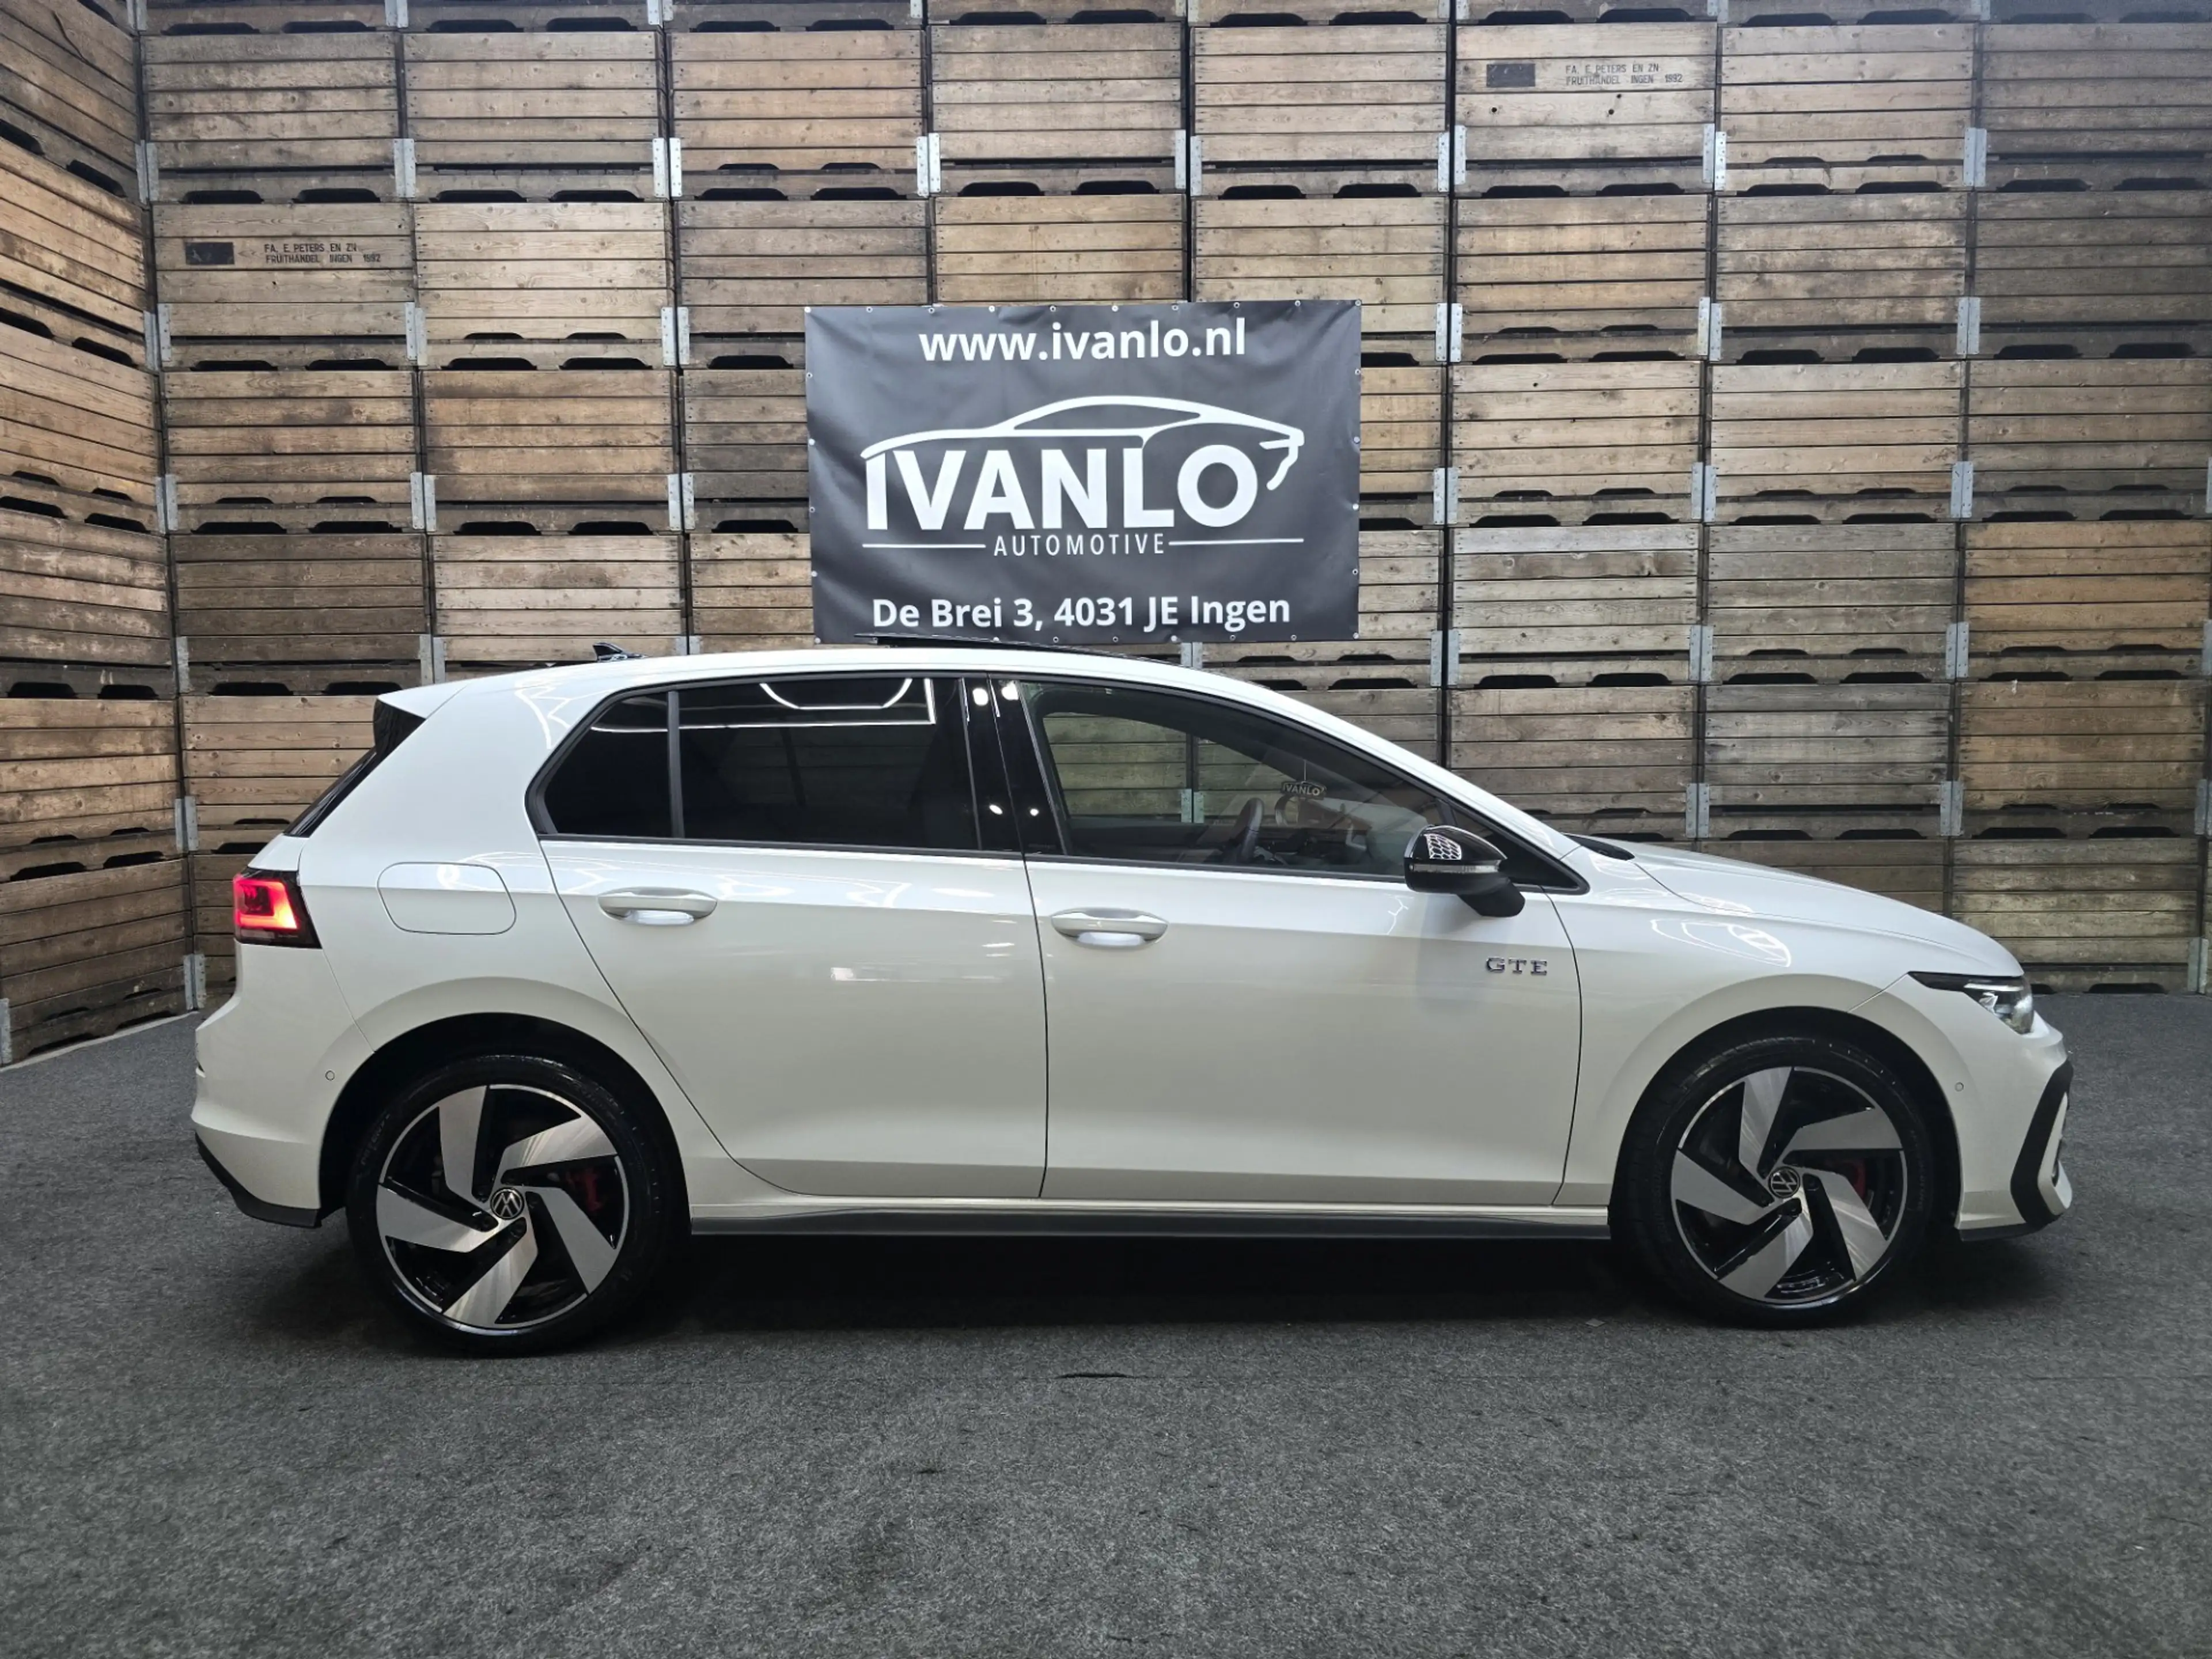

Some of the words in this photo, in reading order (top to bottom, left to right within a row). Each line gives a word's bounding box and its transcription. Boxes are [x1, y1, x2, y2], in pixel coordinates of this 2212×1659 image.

[1595, 64, 1627, 73] PETERS
[1633, 63, 1643, 73] EN
[1647, 63, 1659, 72] ZN
[1566, 75, 1620, 86] FRUITHANDEL
[1631, 74, 1654, 84] INGEN
[294, 243, 325, 252] PETERS
[330, 243, 341, 252] EN
[346, 243, 357, 252] ZN
[266, 253, 320, 264] FRUITHANDEL
[329, 253, 353, 263] INGEN
[919, 318, 1245, 362] www.ivanlo.nl
[865, 444, 1258, 531] IVANLO
[994, 533, 1164, 556] AUTOMOTIVE
[873, 599, 920, 627] De
[931, 597, 1002, 627] Brei
[1013, 598, 1043, 631] 3,
[1054, 597, 1132, 627] 4031
[1143, 596, 1179, 632] JE
[1191, 596, 1290, 632] Ingen
[1485, 956, 1548, 976] GTE
